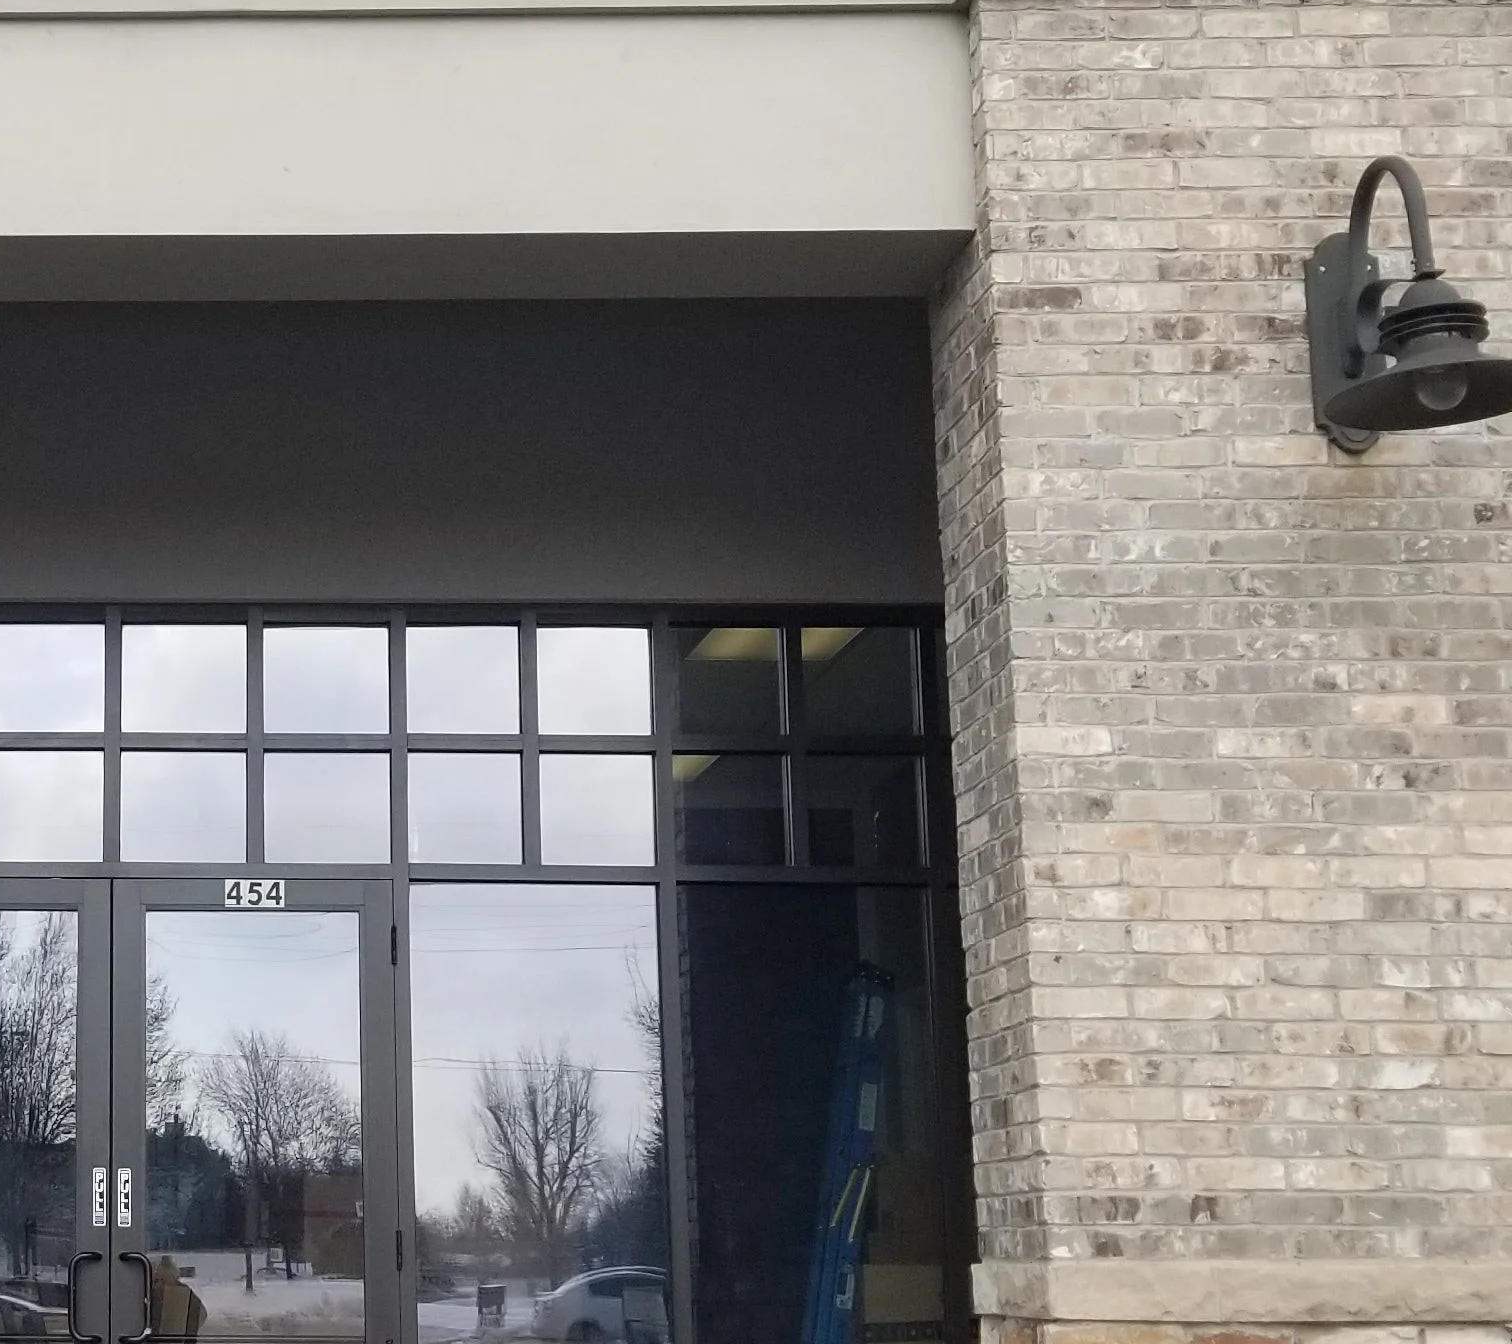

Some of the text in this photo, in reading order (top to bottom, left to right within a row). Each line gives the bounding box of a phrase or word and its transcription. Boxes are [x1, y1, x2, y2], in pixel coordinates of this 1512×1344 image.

[226, 881, 283, 906] 454
[94, 1171, 105, 1213] PULL
[119, 1172, 130, 1214] PULL
